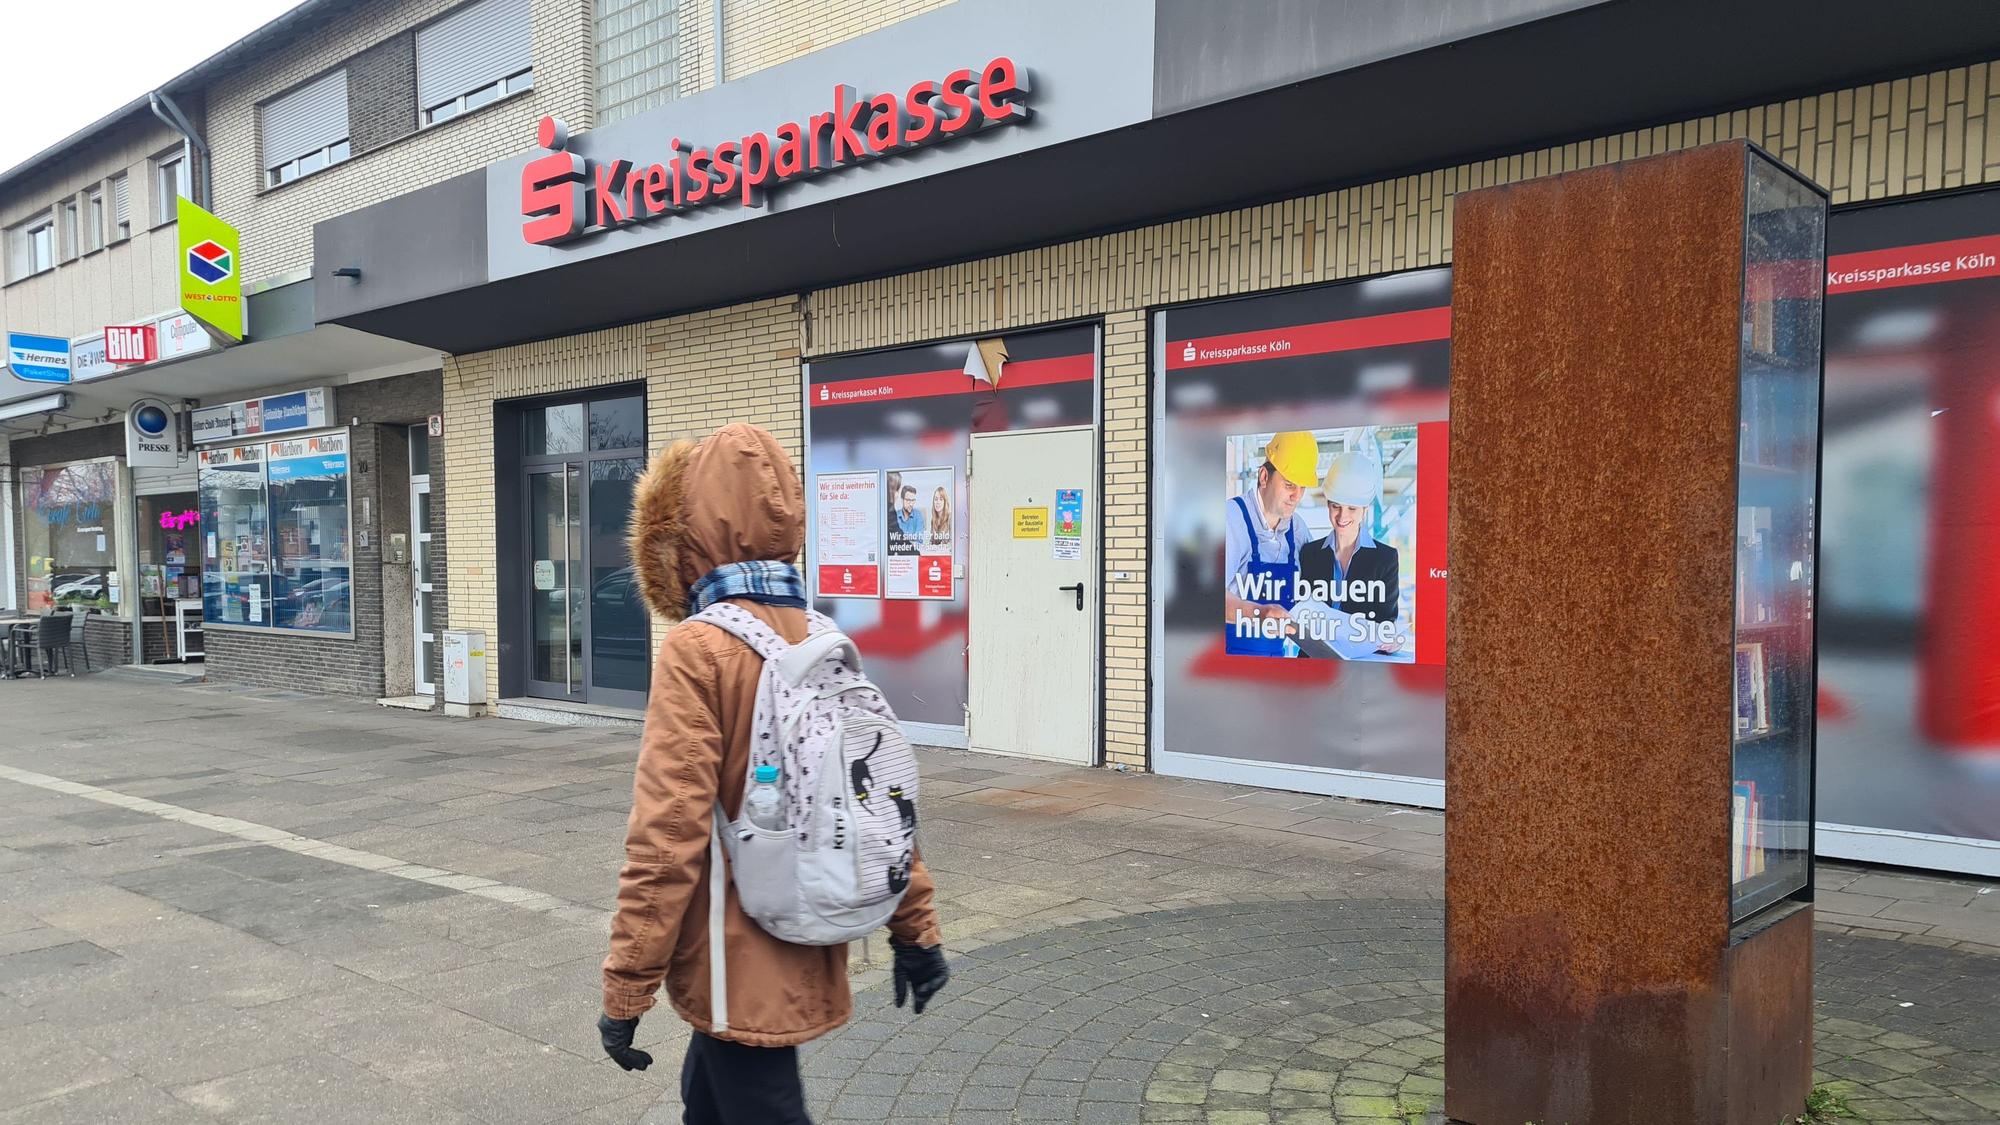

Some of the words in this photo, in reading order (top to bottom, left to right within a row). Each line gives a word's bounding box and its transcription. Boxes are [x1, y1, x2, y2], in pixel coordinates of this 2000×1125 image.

[595, 56, 1022, 227] Kreissparkasse
[1827, 262, 1951, 286] Kreissparkasse
[1956, 252, 1996, 271] Köln
[108, 327, 145, 361] Bild
[1200, 344, 1268, 360] Kreissparkasse
[1269, 339, 1291, 352] Köln
[26, 352, 67, 366] Hermes
[831, 388, 878, 400] Kreissparkasse
[878, 385, 894, 395] Köln
[138, 443, 171, 453] PRESSE
[819, 483, 830, 491] Wir
[832, 481, 844, 490] sind
[845, 481, 876, 490] weiterhin
[819, 493, 828, 501] für
[829, 492, 839, 500] Sie
[889, 531, 901, 541] Wir
[902, 531, 917, 541] sind
[933, 530, 950, 540] bald
[889, 542, 912, 552] wieder
[1235, 571, 1286, 601] Wir
[1293, 571, 1386, 602] bauen
[1235, 608, 1291, 639] hier
[1297, 609, 1342, 641] für
[1349, 611, 1406, 644] Sie.
